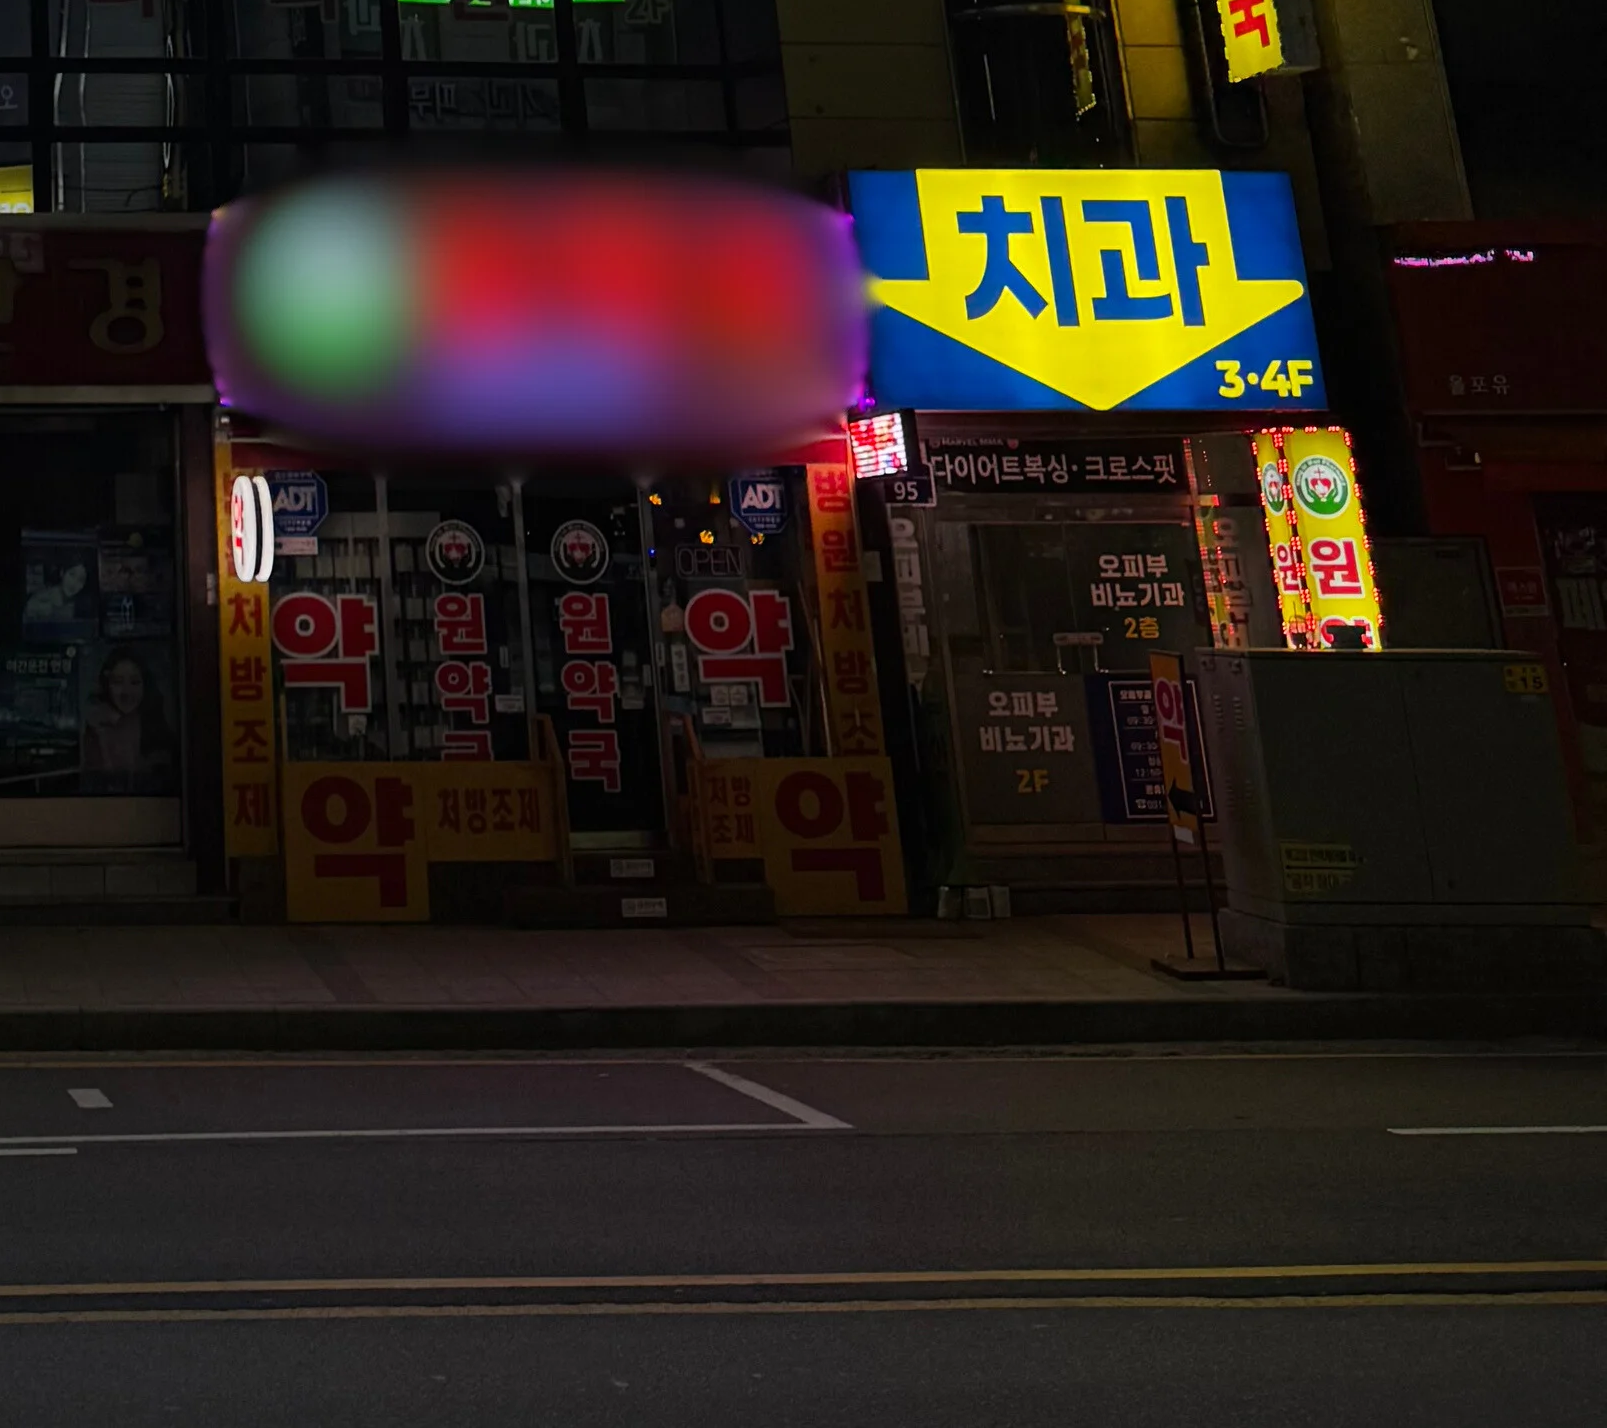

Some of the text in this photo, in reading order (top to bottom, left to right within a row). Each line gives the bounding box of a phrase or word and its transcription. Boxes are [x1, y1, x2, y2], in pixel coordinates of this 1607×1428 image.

[955, 194, 1211, 328] 치과
[1084, 453, 1178, 486] 크로스핏
[740, 484, 785, 510] ADT
[894, 481, 920, 502] 95
[678, 548, 744, 576] OPEN
[1097, 551, 1170, 579] 오피부
[1090, 581, 1185, 610] 비뇨기과
[1122, 616, 1161, 640] 2층
[272, 591, 382, 713] 약
[684, 588, 794, 708] 약
[558, 591, 622, 794] 원약국
[988, 690, 1060, 718] 오피부
[1155, 678, 1190, 765] 약
[978, 724, 1076, 753] 비뇨기과
[706, 774, 752, 807] 처방
[1015, 768, 1050, 795] 2F
[436, 787, 542, 836] 처방조제
[300, 775, 416, 908] 약
[710, 814, 756, 846] 조제
[774, 769, 890, 904] 약
